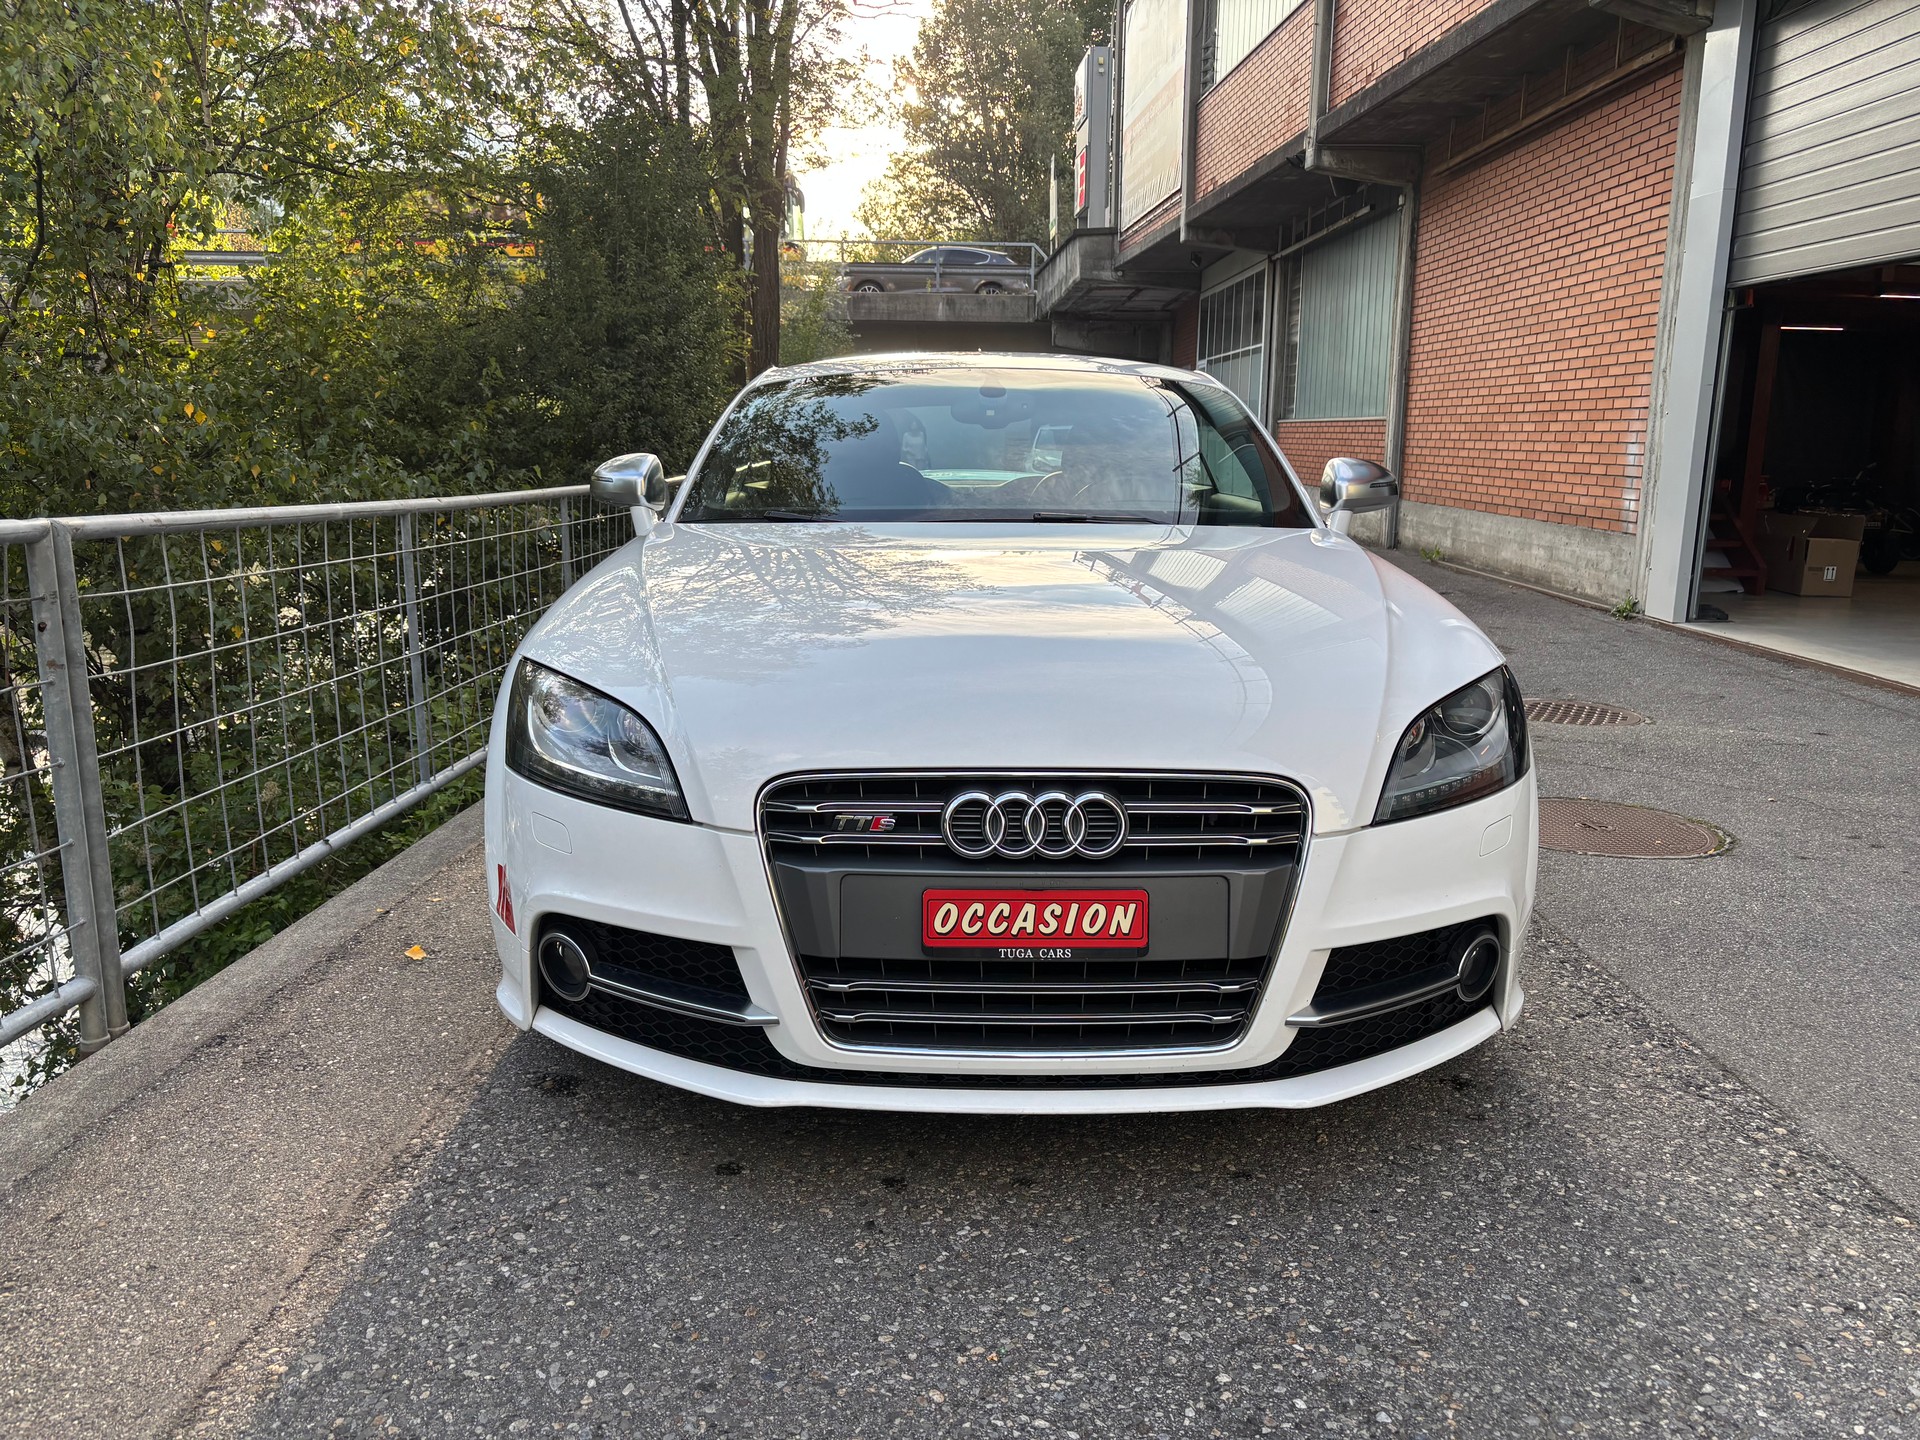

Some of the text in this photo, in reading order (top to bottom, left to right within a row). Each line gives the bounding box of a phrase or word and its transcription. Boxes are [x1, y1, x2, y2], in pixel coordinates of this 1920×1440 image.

[834, 815, 896, 831] TTS
[933, 902, 1138, 937] OCCASION
[998, 948, 1072, 959] TUGA CARS
